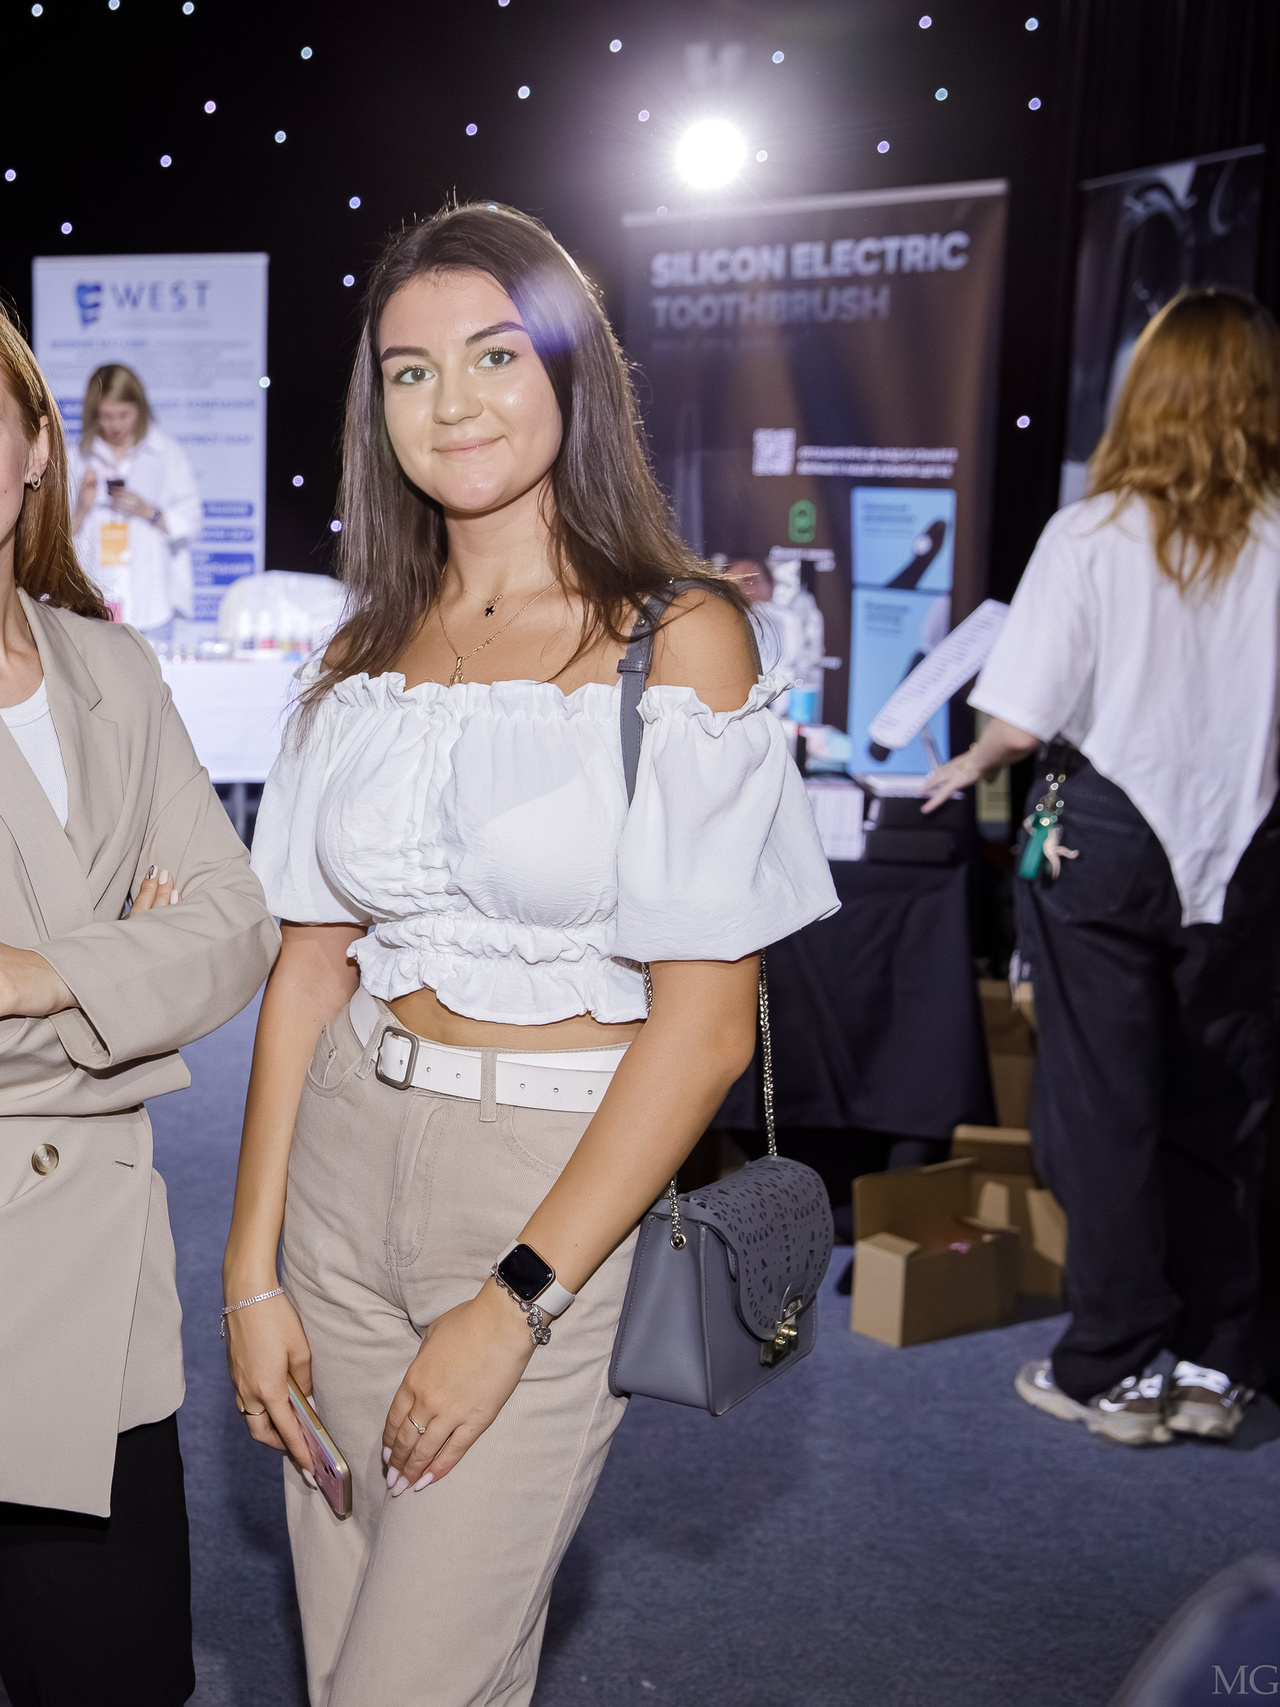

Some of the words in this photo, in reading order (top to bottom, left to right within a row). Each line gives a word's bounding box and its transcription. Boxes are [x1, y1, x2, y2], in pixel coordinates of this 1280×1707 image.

[651, 244, 786, 288] SILICON
[790, 230, 970, 280] ELECTRIC
[110, 280, 211, 312] WEST
[651, 284, 890, 329] TOOTHBRUSH
